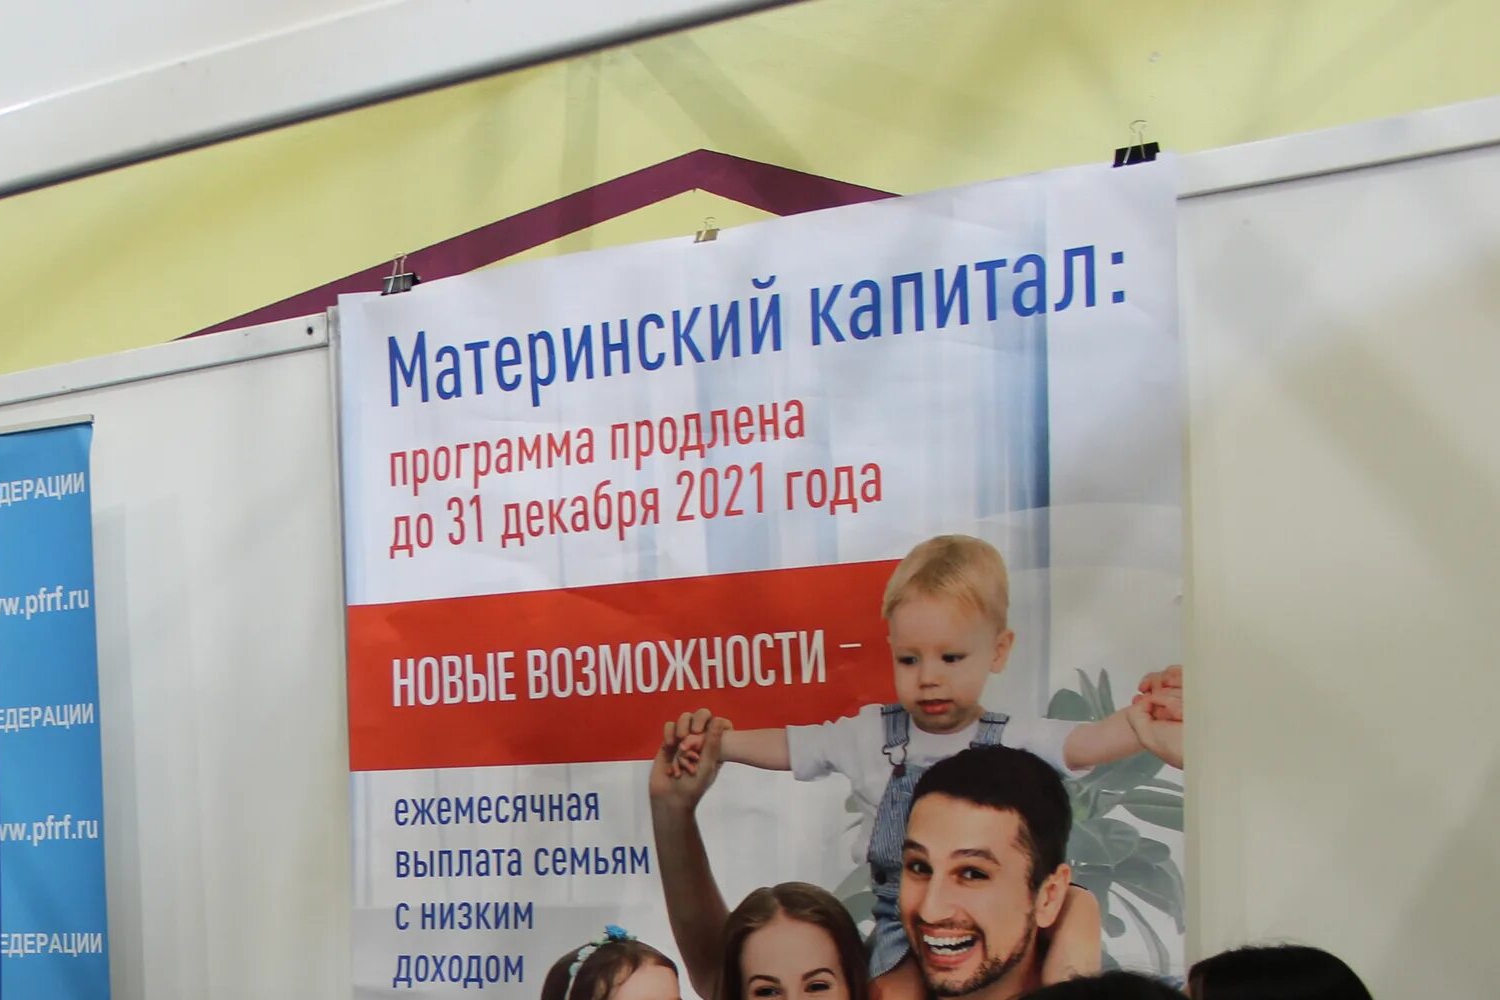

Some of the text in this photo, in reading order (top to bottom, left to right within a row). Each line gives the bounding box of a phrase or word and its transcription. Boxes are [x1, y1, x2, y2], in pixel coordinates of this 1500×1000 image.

[388, 245, 1125, 407] Материнский капитал:
[390, 399, 805, 496] программа продлена
[390, 462, 883, 559] до 31 декабря 2021 года
[392, 650, 517, 707] НОВЫЕ
[527, 629, 827, 700] ВОЗМОЖНОСТИ
[394, 791, 600, 826] ежемесячная
[396, 845, 650, 879] выплата семьям
[395, 900, 534, 931] с низким
[394, 953, 524, 989] доходом
